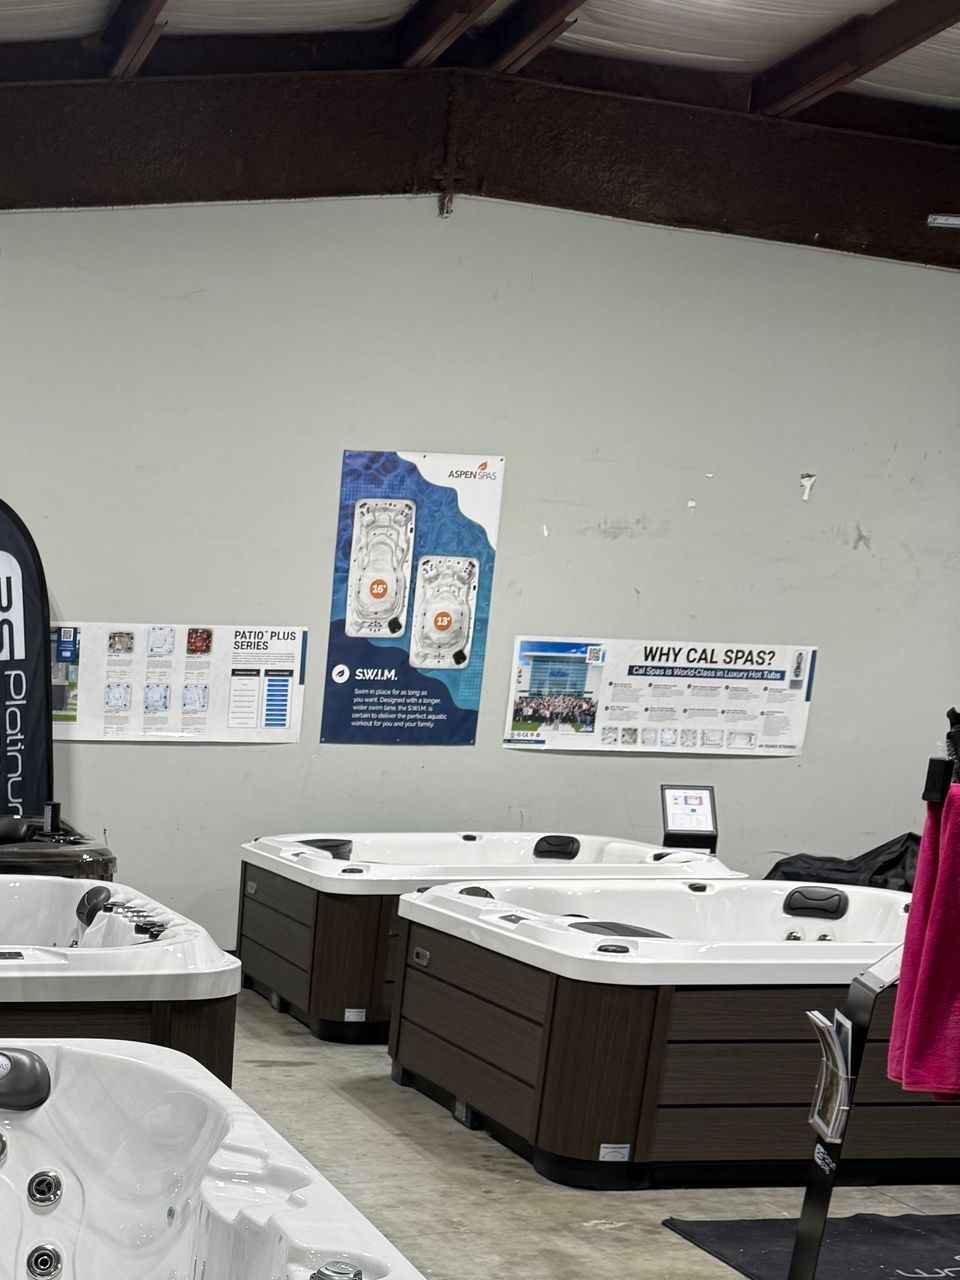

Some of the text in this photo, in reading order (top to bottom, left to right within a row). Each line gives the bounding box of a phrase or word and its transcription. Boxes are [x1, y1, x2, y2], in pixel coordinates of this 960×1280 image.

[448, 470, 496, 480] ASPEN SPAS
[270, 631, 296, 640] PLUS
[233, 640, 268, 650] SERIES
[643, 646, 679, 663] WHY
[686, 648, 719, 664] CAL
[723, 649, 776, 666] SPAS?
[355, 668, 398, 680] S.W.I.M.
[633, 666, 781, 680] Cal Spas is World-Class in Luxury Hot Tubs
